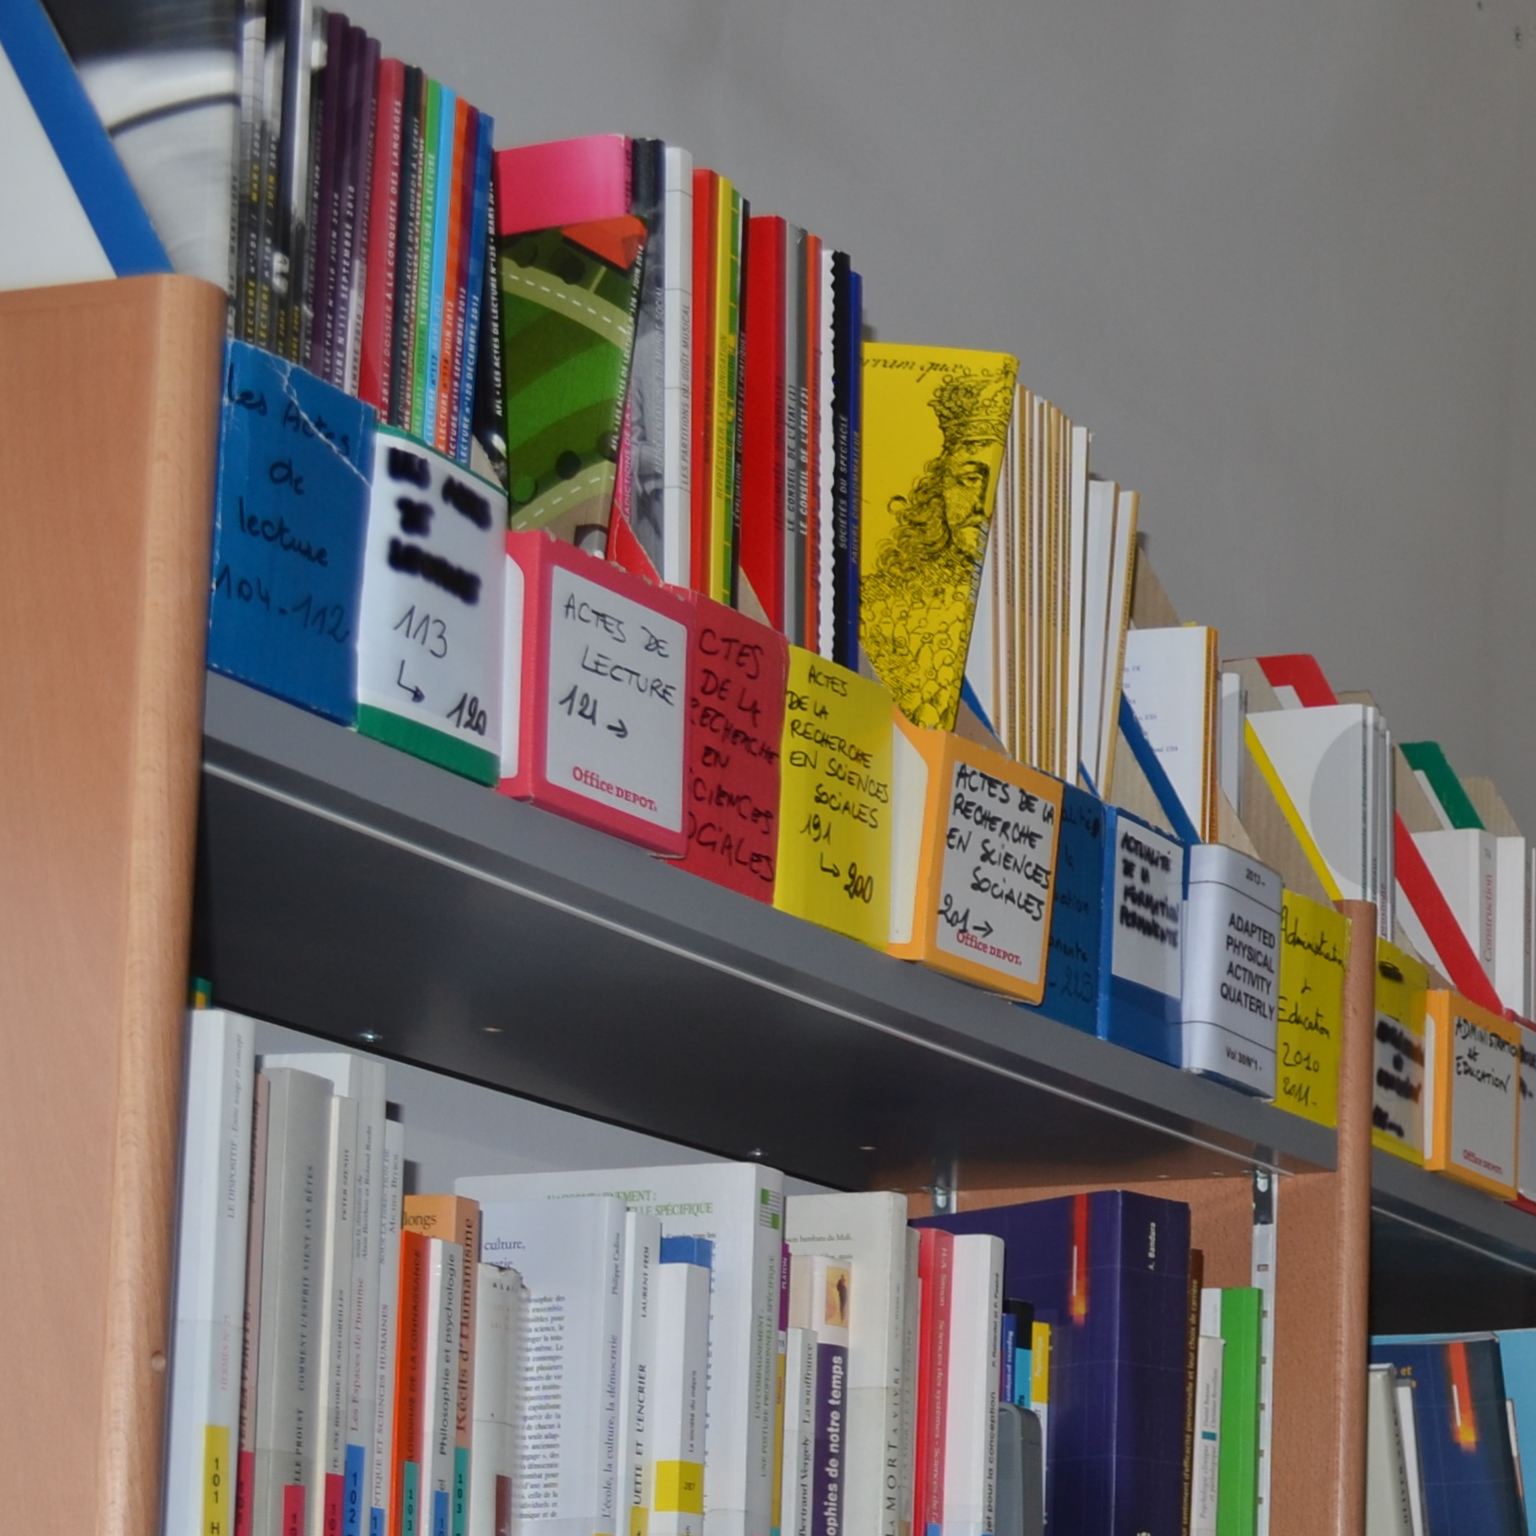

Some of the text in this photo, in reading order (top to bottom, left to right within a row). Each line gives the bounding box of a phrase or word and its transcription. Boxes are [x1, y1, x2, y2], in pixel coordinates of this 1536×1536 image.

[487, 208, 495, 235] MARS
[490, 277, 498, 320] LECTURE
[491, 322, 499, 335] DE
[682, 304, 690, 349] MUSICAL
[492, 338, 500, 368] ACTES
[680, 352, 690, 381] GOÛT
[459, 417, 470, 463] LECTURE
[470, 294, 479, 321] 2012
[493, 371, 501, 388] LES
[682, 385, 690, 398] DU
[494, 399, 503, 417] AFL
[785, 405, 796, 440] L'ÉTAT
[681, 403, 690, 463] PARTITIONS
[788, 446, 795, 460] DE
[269, 459, 305, 496] de
[787, 468, 795, 513] CONSEIL
[838, 415, 849, 550] SOCIÉTÉS DU SPECTACLE
[239, 495, 329, 568] lecture
[787, 519, 795, 532] LE
[393, 605, 448, 659] 113
[564, 593, 670, 659] ACTES DE
[698, 629, 764, 680] CTES
[581, 645, 677, 706] LECTURE
[808, 665, 848, 698] ACTES
[701, 669, 762, 728] DE LA
[787, 690, 829, 721] DE LA
[701, 745, 729, 769] EN
[789, 750, 818, 770] EN
[790, 719, 874, 769] RECHERCHE
[572, 765, 613, 796] Office
[956, 763, 1011, 804] ACTES
[1019, 788, 1039, 813] DE
[689, 766, 774, 836] CIENCES
[800, 813, 831, 845] 191
[946, 827, 973, 854] EN
[953, 792, 1043, 850] RECHERCHE
[937, 893, 970, 934] 201
[1228, 912, 1276, 950] ADAPTED
[1483, 874, 1494, 962] Construction
[956, 929, 988, 955] Office
[1226, 935, 1275, 974] PHYSICAL
[1280, 905, 1346, 972] Administration
[1226, 961, 1272, 996] ACTIVITY
[1220, 982, 1275, 1021] QUATERLY
[1282, 1042, 1320, 1073] 2010
[454, 1218, 474, 1433] Récits d'Humanisme
[439, 1253, 457, 1456] Philosophie et psychologie
[828, 1355, 843, 1406] temps
[601, 1334, 619, 1518] L'école, la culture, la démocratie
[825, 1410, 841, 1453] notre
[824, 1458, 839, 1478] de
